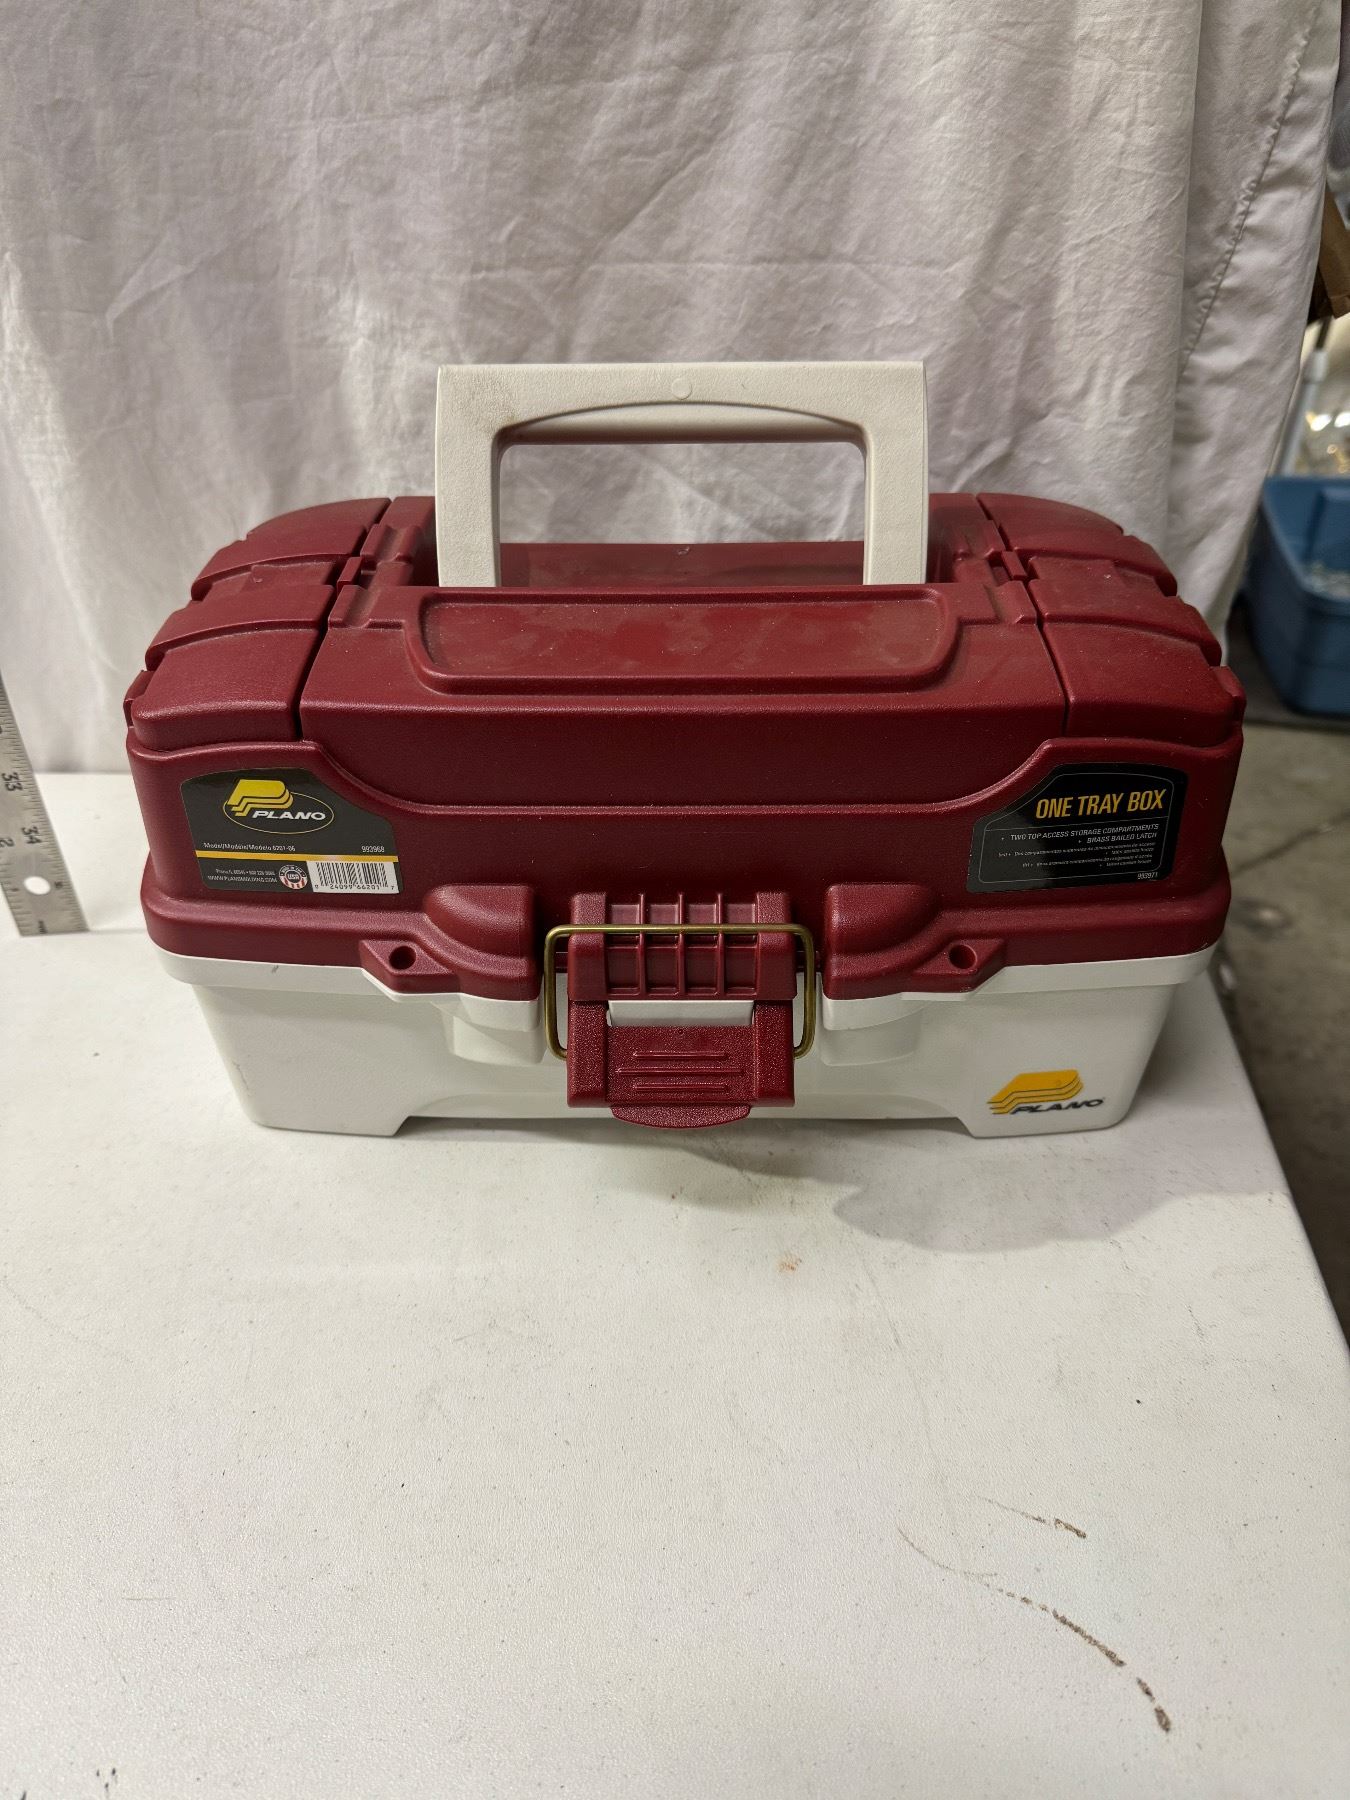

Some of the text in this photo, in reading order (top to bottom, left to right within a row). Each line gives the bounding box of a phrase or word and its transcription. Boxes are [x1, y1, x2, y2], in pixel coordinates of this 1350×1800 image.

[1, 772, 24, 792] 33
[1036, 789, 1166, 818] ONE TRAY BOX
[251, 809, 326, 821] PLANO
[21, 825, 43, 845] 34
[1027, 832, 1042, 840] TOP
[1041, 830, 1070, 840] ACCESS
[1070, 827, 1102, 837] STORAGE
[1102, 823, 1160, 835] COMPARTMENTS
[1086, 831, 1158, 844] BRASS BAILED LATCH
[1009, 1099, 1104, 1115] PLANO
